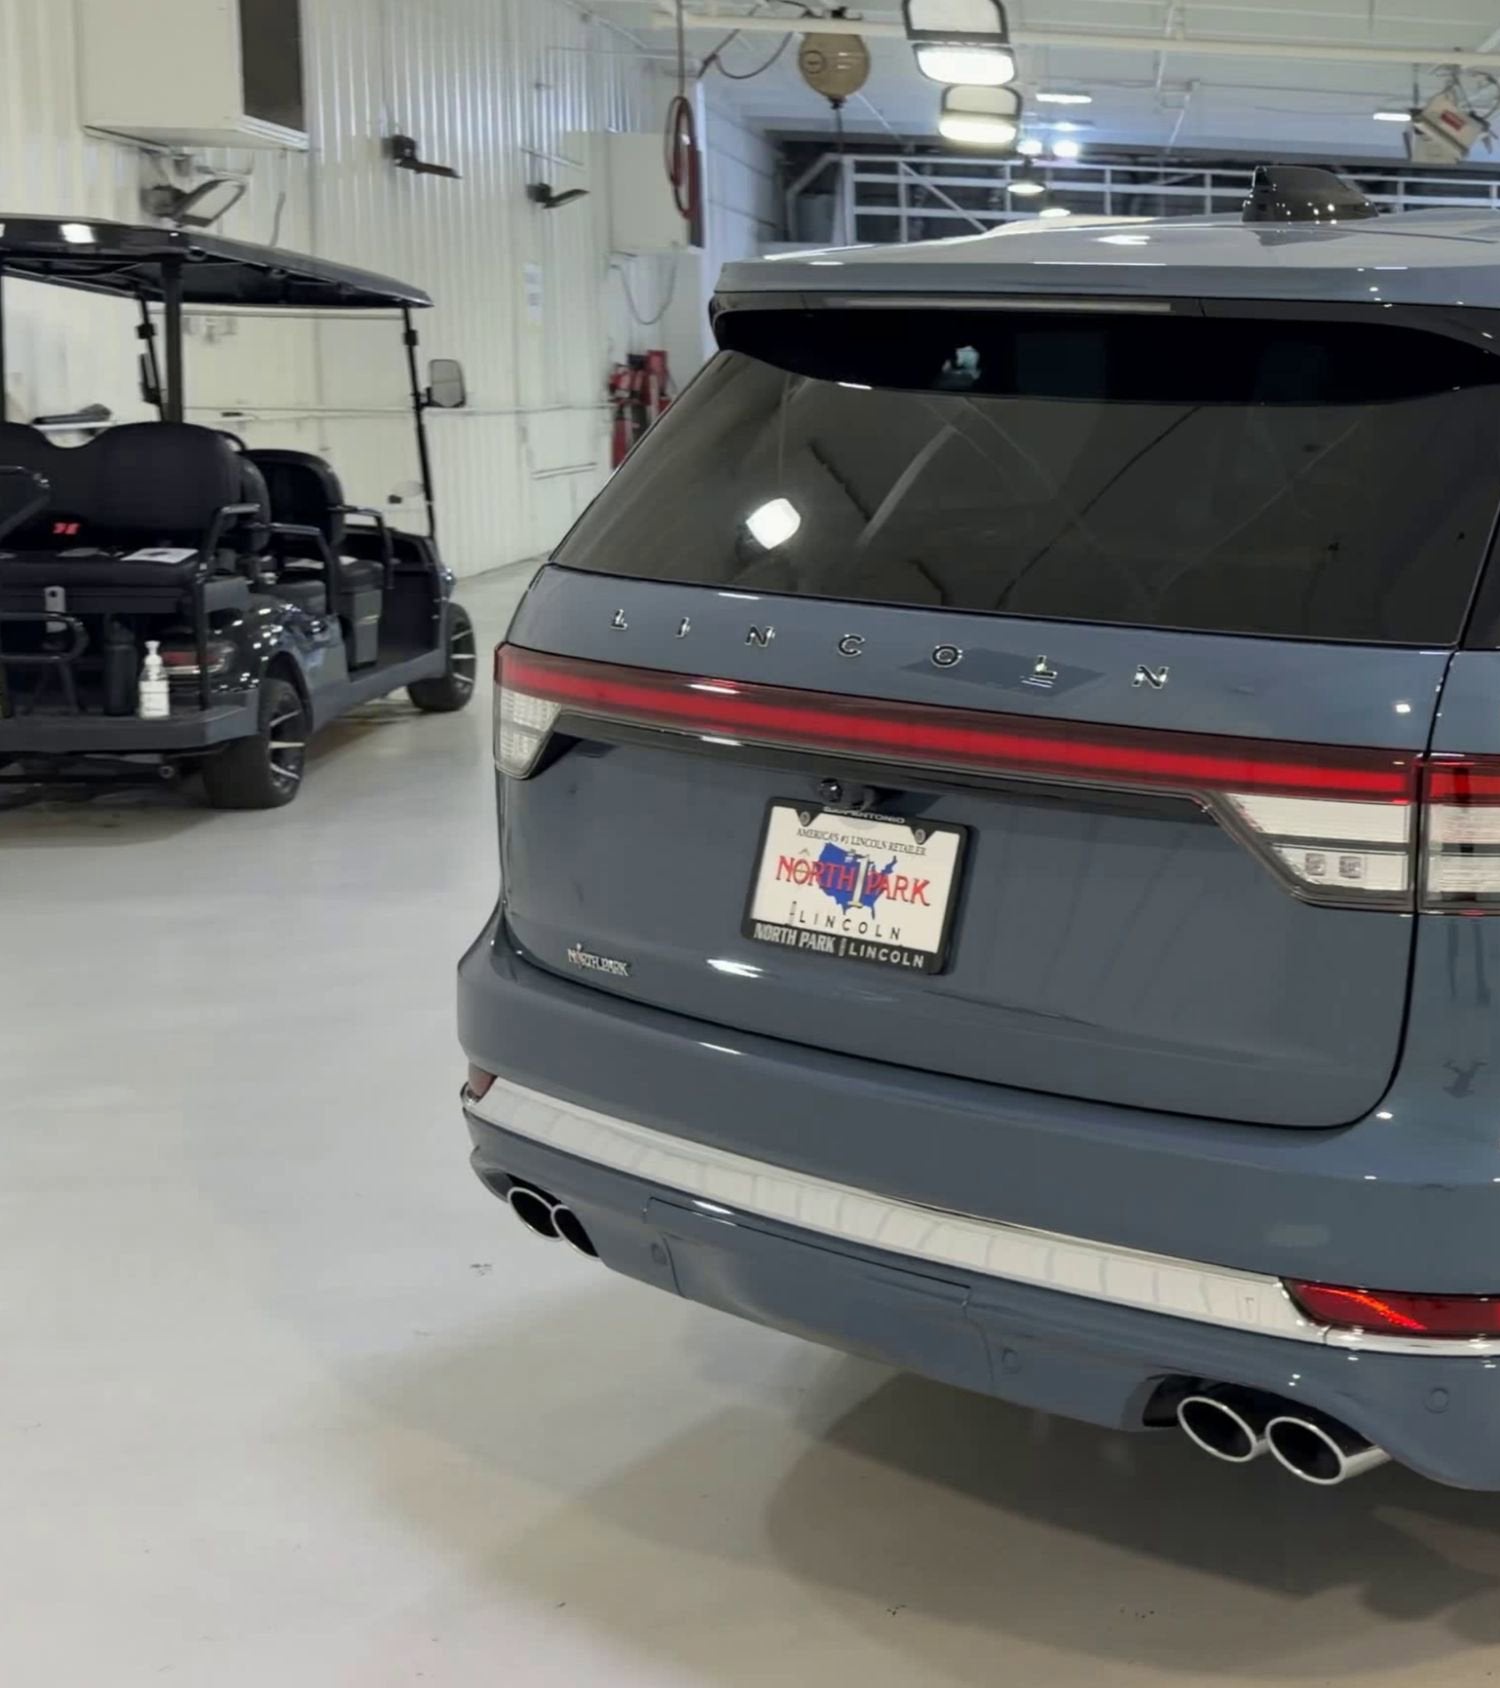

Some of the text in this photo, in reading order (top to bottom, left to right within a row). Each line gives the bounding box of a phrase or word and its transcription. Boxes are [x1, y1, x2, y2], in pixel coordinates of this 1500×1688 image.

[610, 608, 1170, 689] LINCOLN
[851, 836, 887, 850] LINCOLN
[888, 842, 926, 856] RETAILER
[776, 855, 931, 907] NORTH PARK
[753, 922, 925, 968] NORTH PARK LINCOLN
[799, 910, 902, 941] LINCOLN
